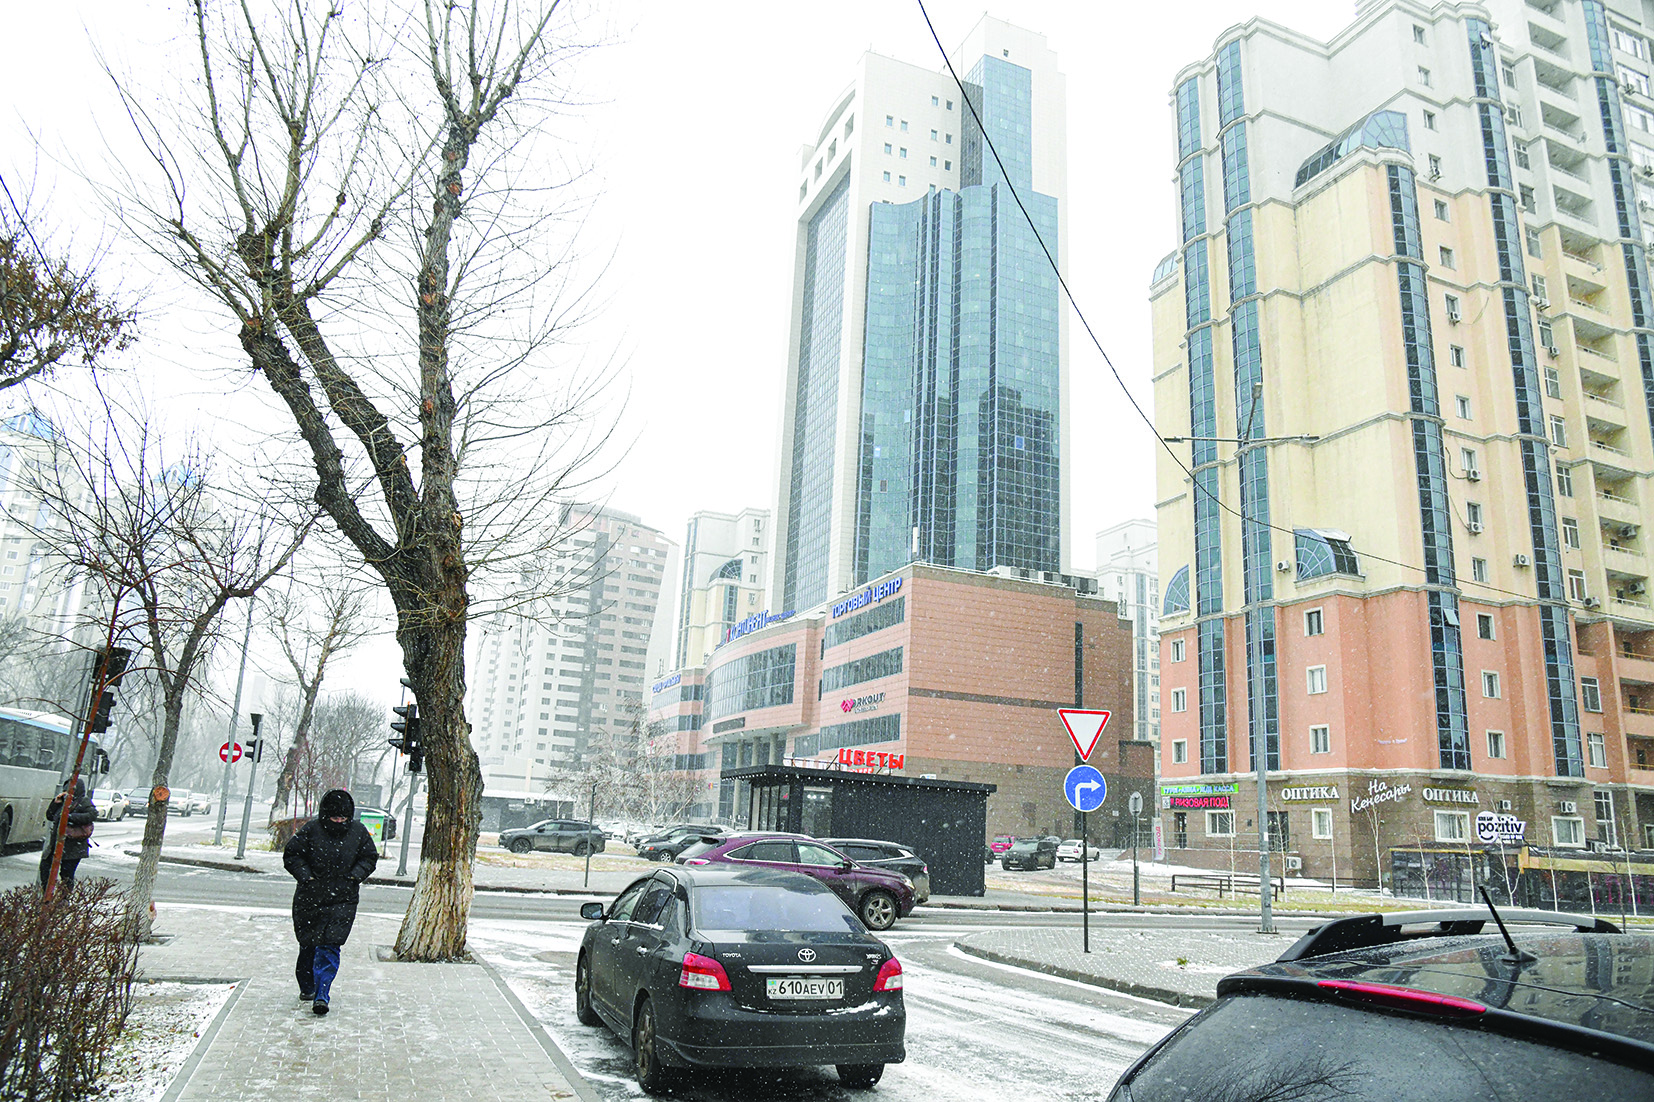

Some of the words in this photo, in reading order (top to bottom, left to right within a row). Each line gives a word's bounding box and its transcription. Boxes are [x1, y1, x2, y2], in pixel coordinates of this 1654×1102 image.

[832, 586, 872, 619] ТОРГОВЫЙ
[873, 577, 902, 603] ЦЕНТР
[838, 748, 904, 770] ЦВЕТЫ
[1214, 785, 1235, 793] КАССА
[1281, 786, 1340, 801] ОПТИКА
[1368, 779, 1387, 796] На
[1422, 787, 1480, 804] ОПТИКА
[1351, 784, 1412, 814] Кенесары
[1478, 817, 1523, 836] pozitiv
[828, 980, 843, 995] 01
